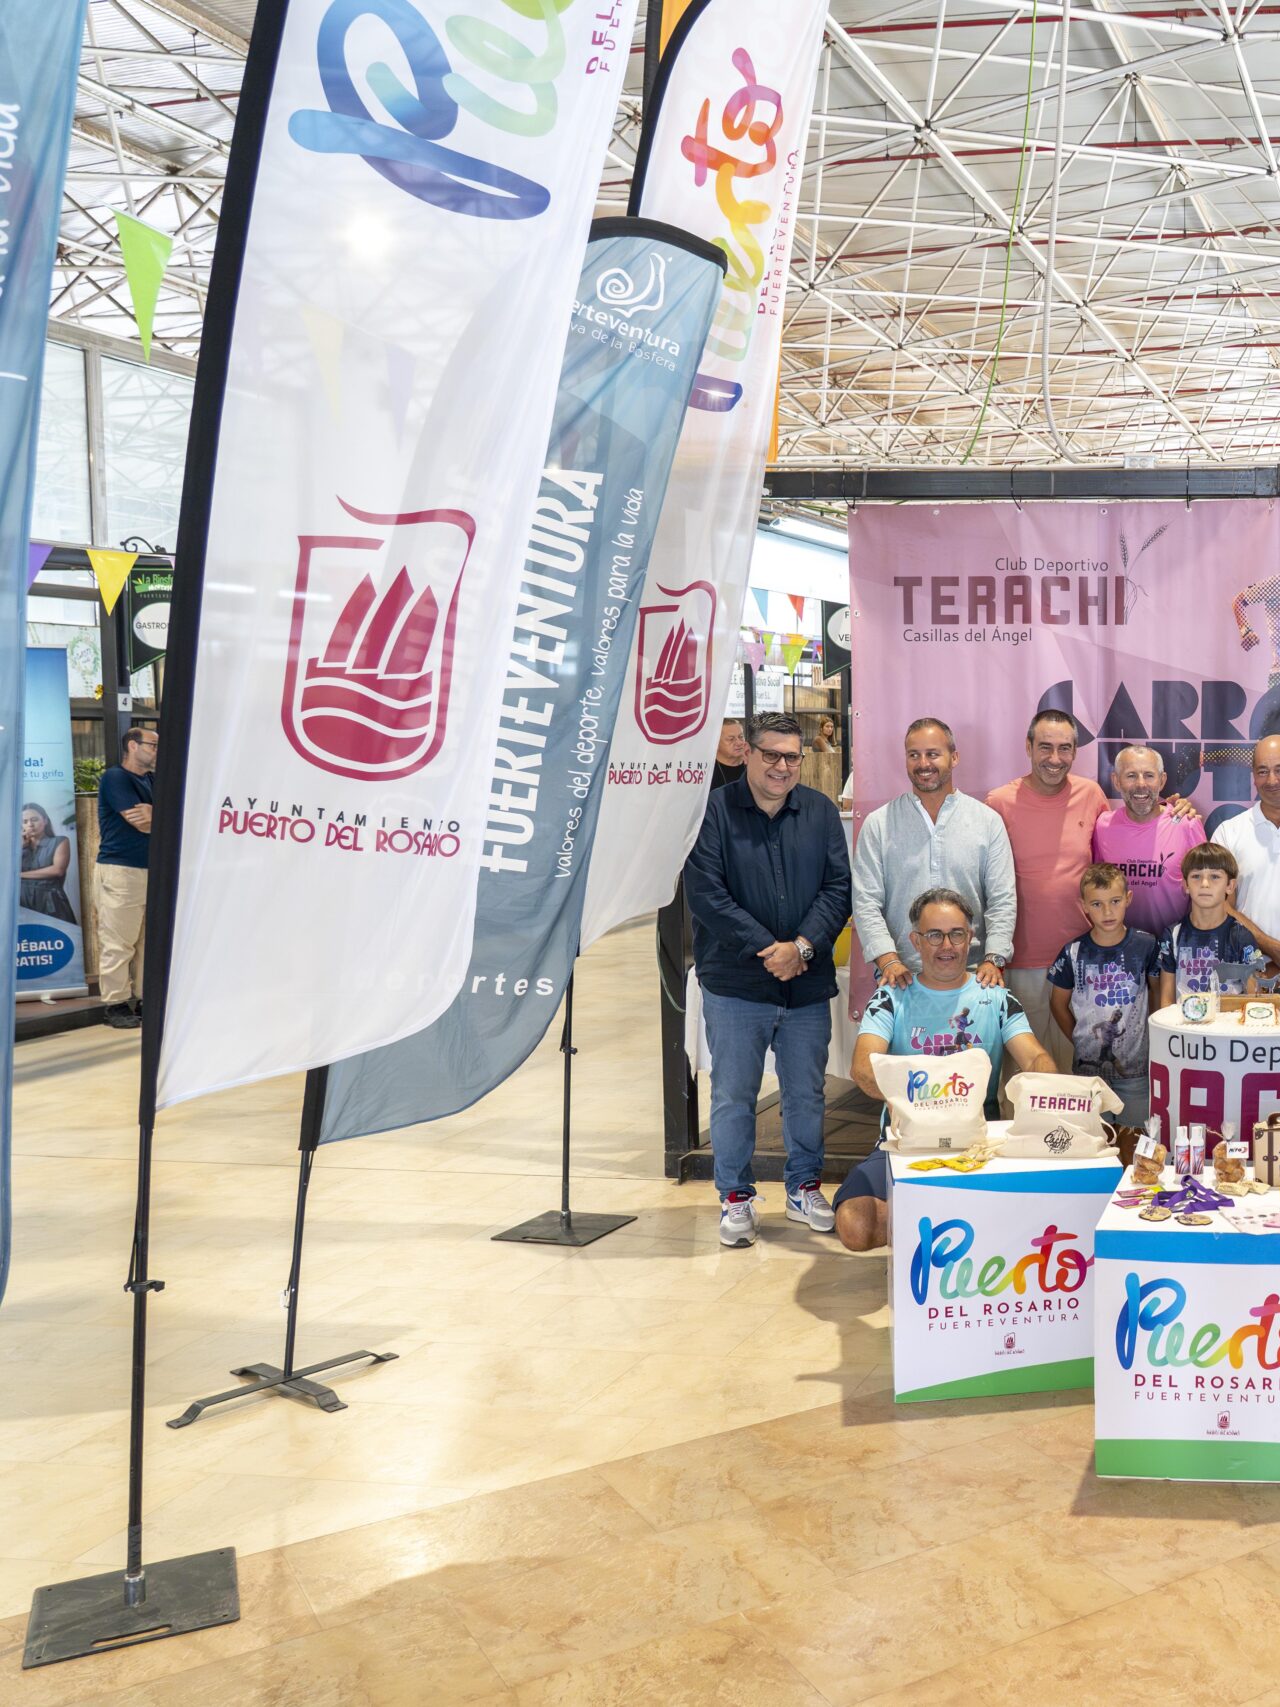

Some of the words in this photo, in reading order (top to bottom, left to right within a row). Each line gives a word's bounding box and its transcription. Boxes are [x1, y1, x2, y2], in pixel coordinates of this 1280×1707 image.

[625, 486, 645, 526] vida
[619, 531, 636, 553] la
[994, 556, 1028, 572] Club
[1033, 557, 1109, 575] Deportivo
[606, 556, 633, 603] para
[893, 575, 1126, 625] TERACHI
[591, 605, 622, 682] valores
[902, 628, 960, 643] Casillas
[964, 627, 987, 642] del
[991, 625, 1033, 646] Ángel
[122, 698, 128, 706] 4
[574, 769, 592, 801] del
[648, 770, 671, 785] DEL
[219, 809, 316, 844] PUERTO
[325, 823, 364, 852] DEL
[555, 806, 584, 879] valores
[1168, 1034, 1217, 1061] Club
[906, 1070, 975, 1103] Puerto
[933, 1097, 968, 1105] ROSARIO
[1030, 1095, 1093, 1113] TERACHI
[910, 1216, 1095, 1306] Puerto
[928, 1306, 968, 1320] DEL
[983, 1297, 1080, 1315] ROSARIO
[928, 1313, 1080, 1332] FUERTEVENTURA
[1134, 1373, 1178, 1388] DEL
